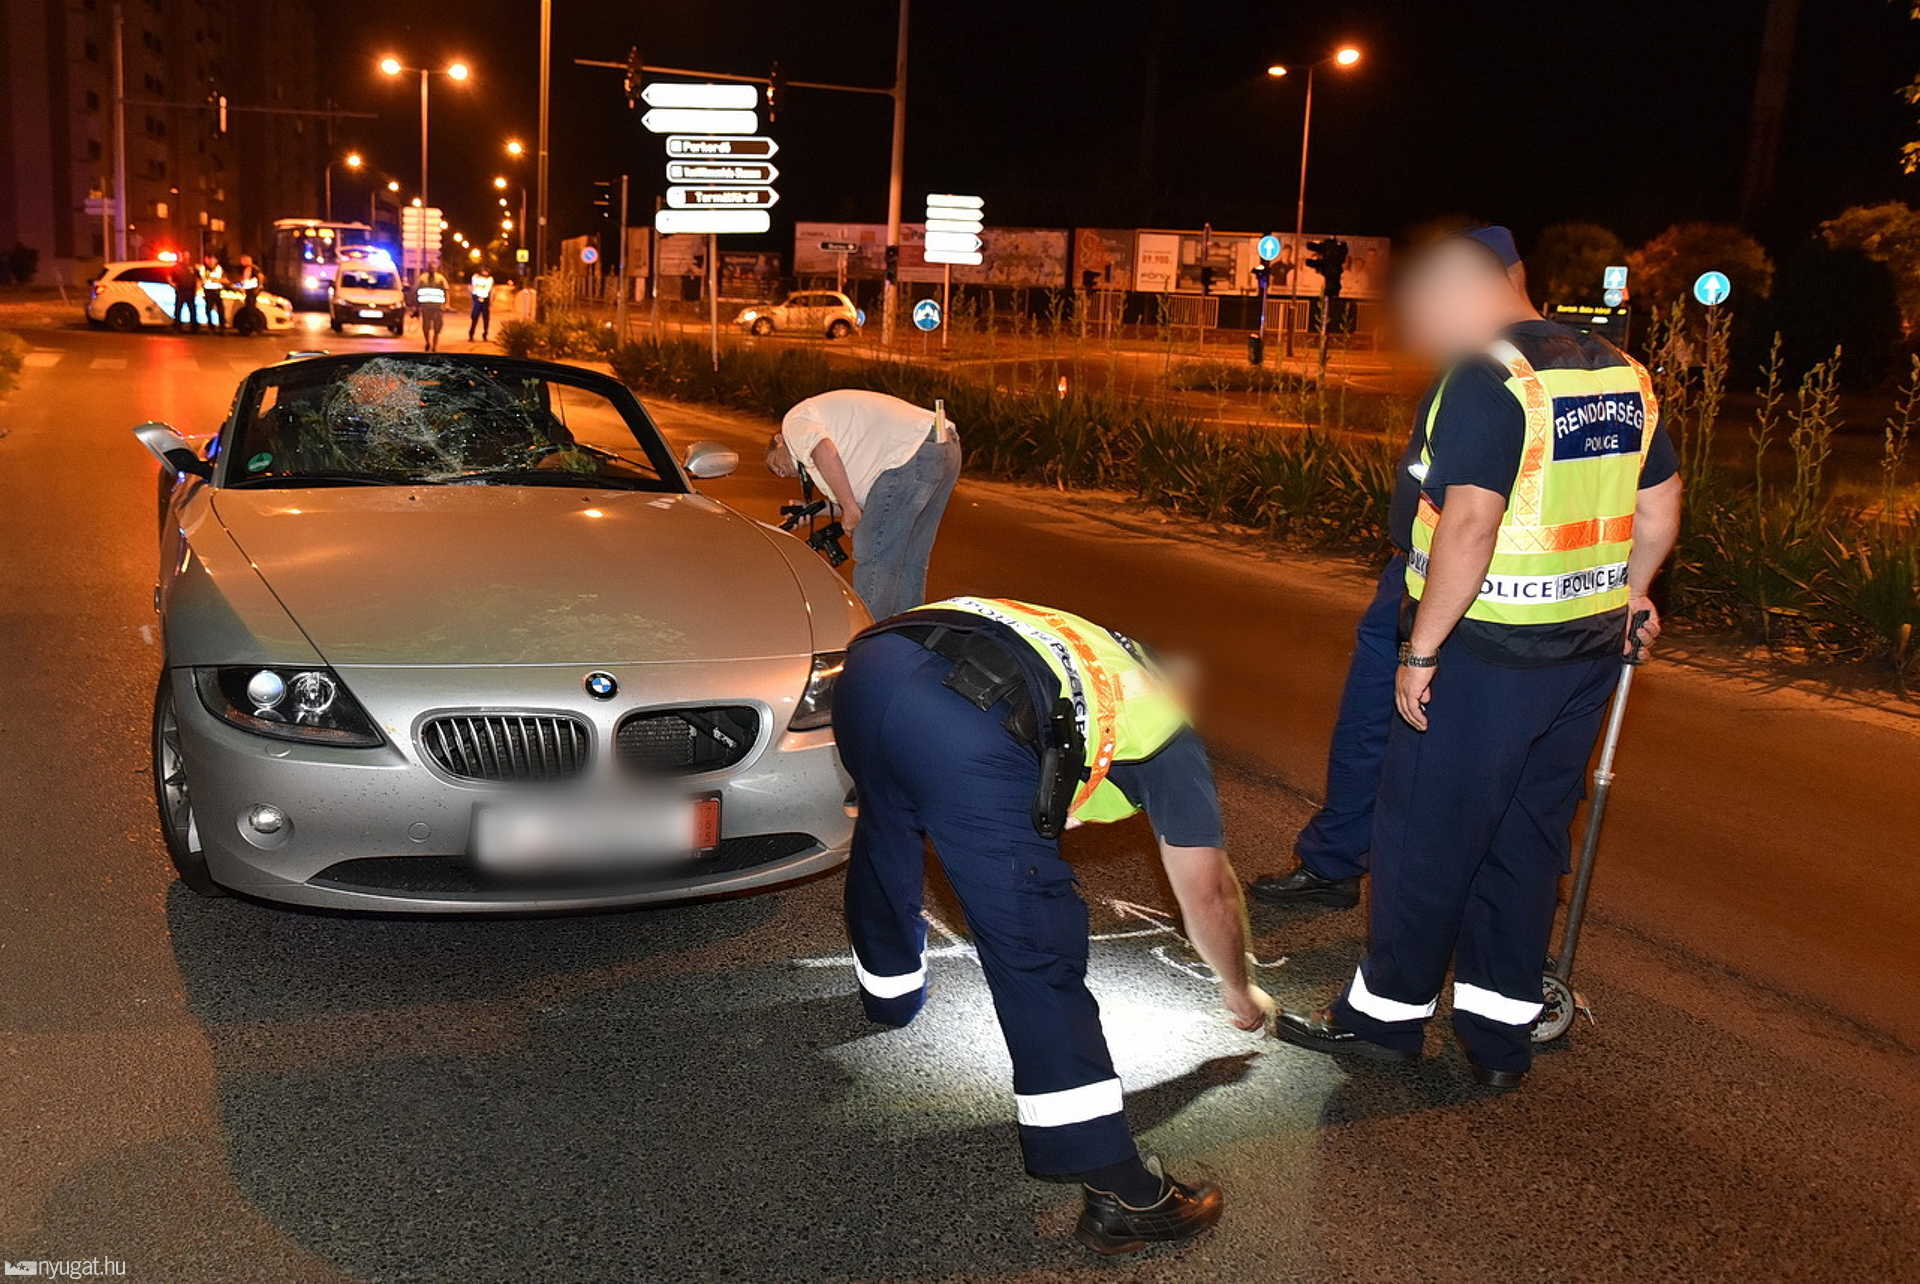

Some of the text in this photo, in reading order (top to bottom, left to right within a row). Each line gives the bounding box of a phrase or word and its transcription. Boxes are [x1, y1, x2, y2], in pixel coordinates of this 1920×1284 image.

[1584, 434, 1619, 452] POLICE
[1480, 579, 1553, 599] OLICE
[1562, 569, 1616, 596] POLICE
